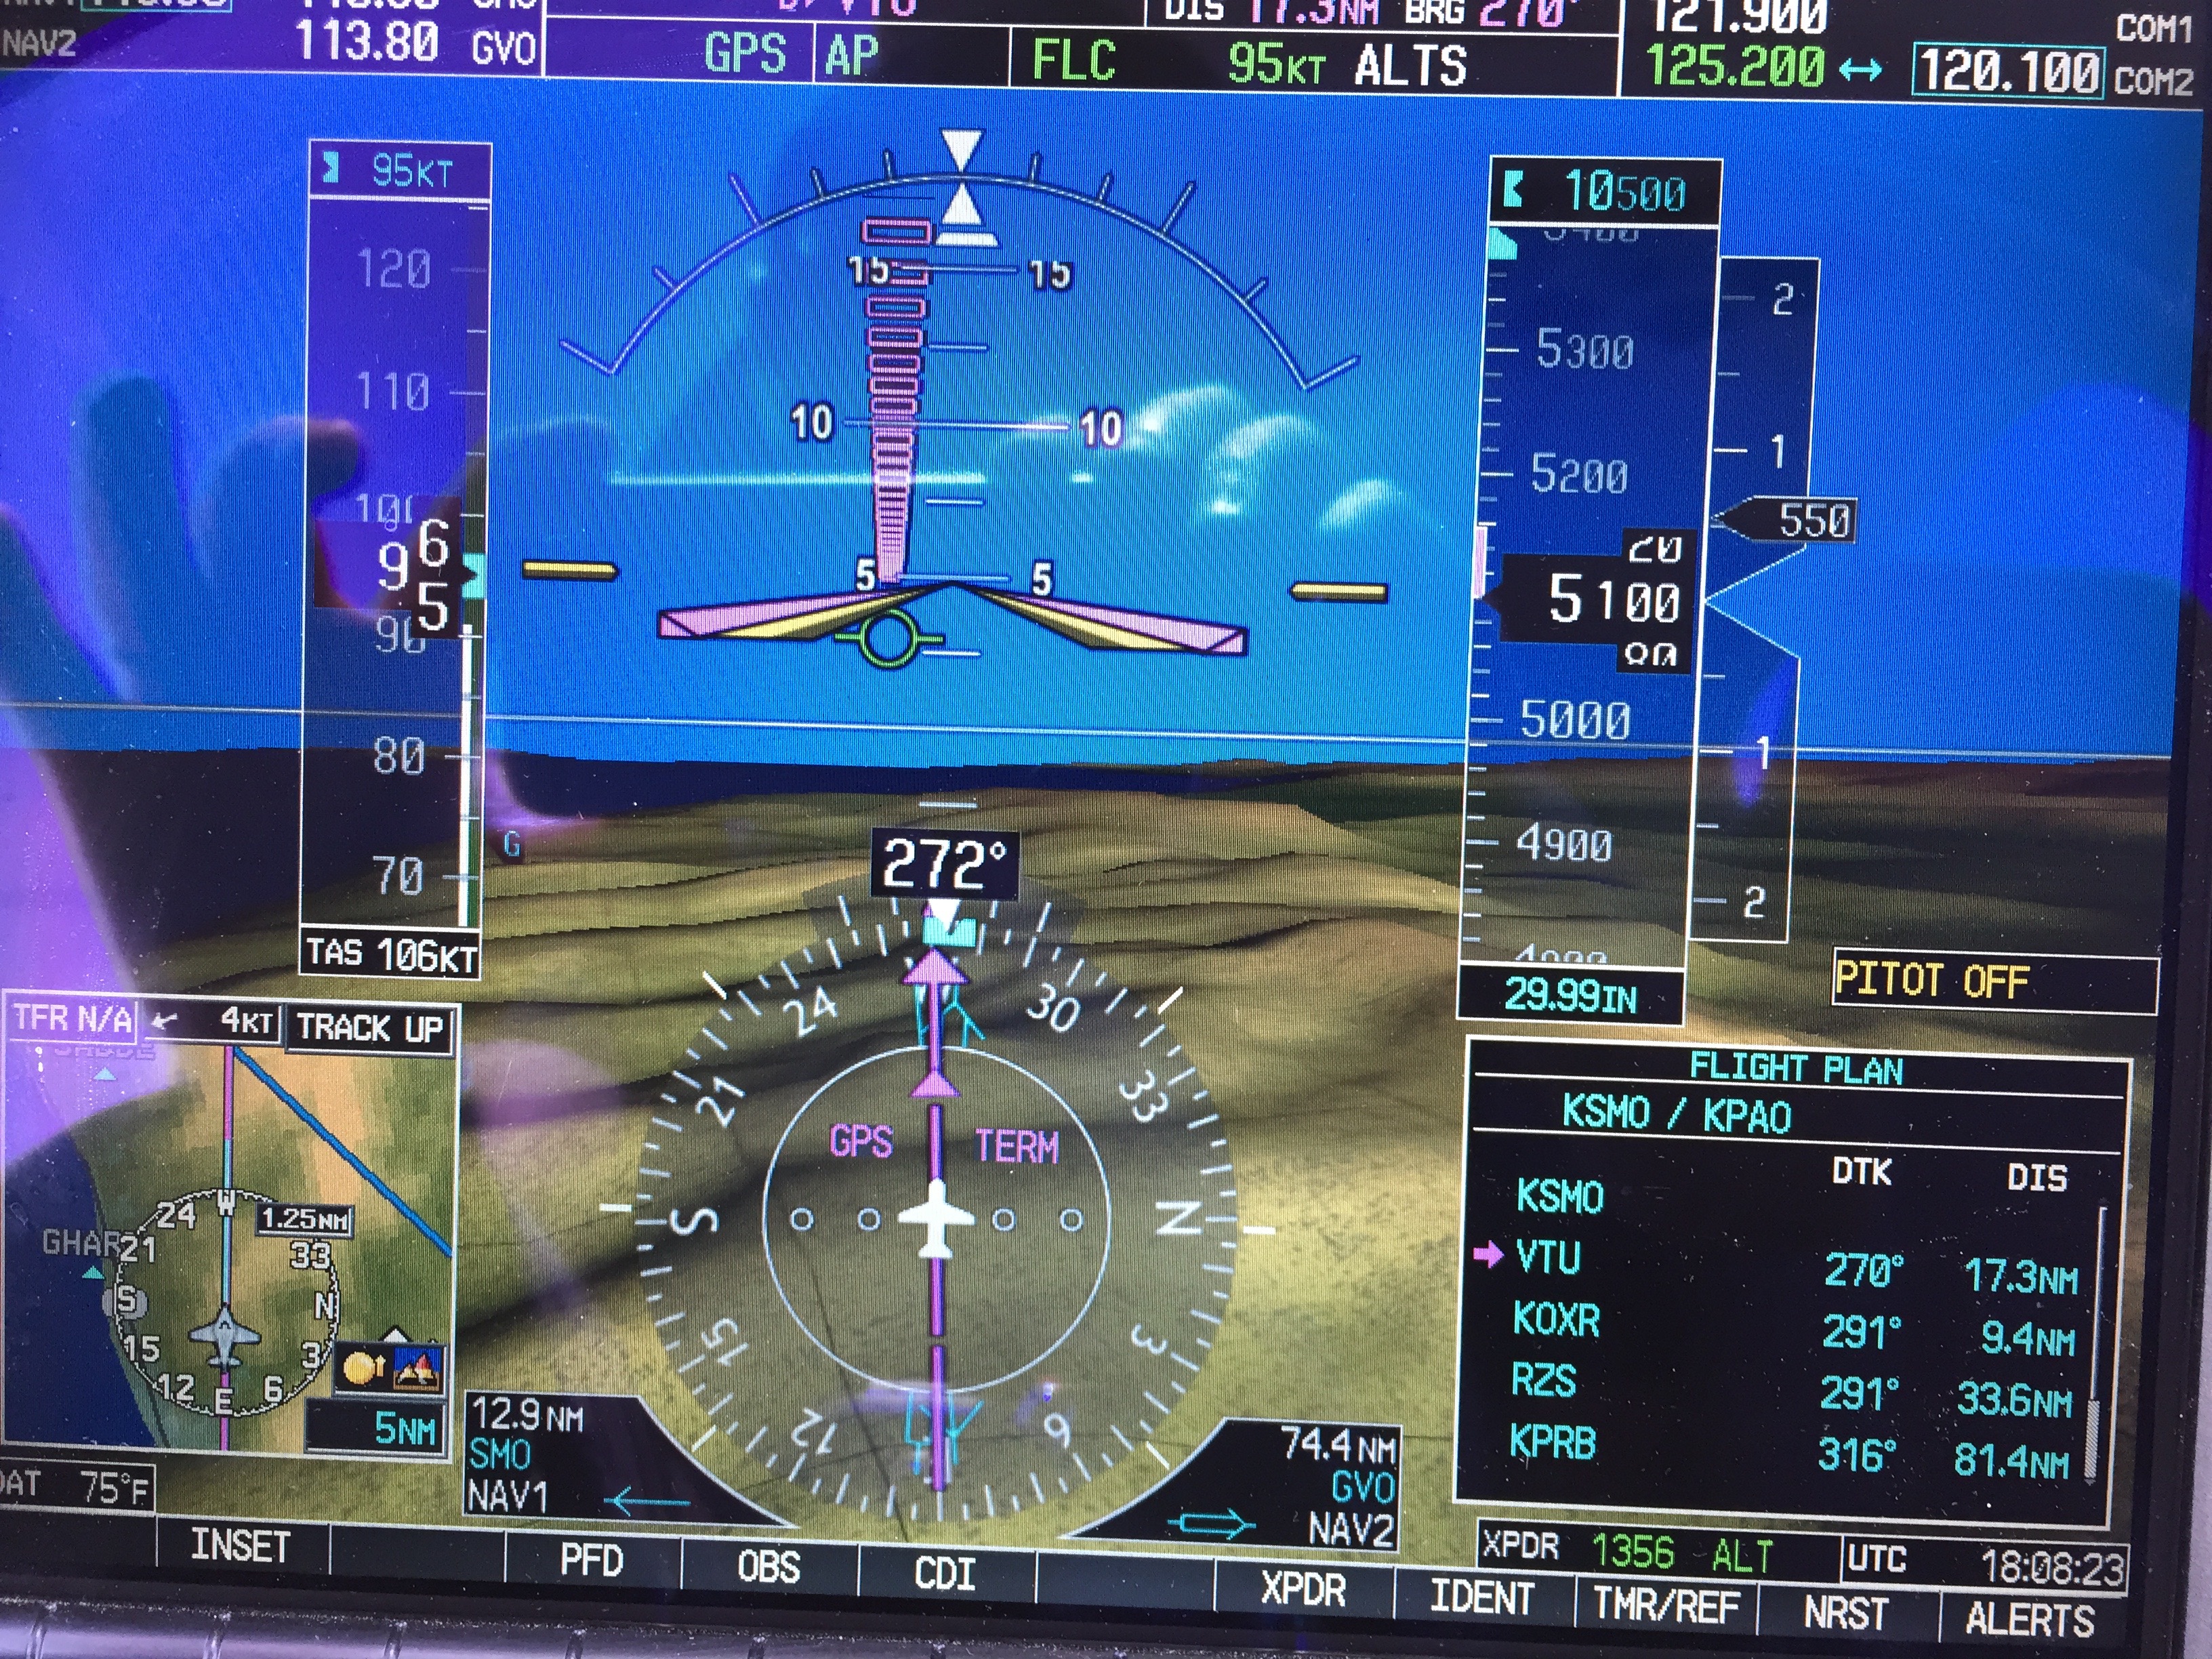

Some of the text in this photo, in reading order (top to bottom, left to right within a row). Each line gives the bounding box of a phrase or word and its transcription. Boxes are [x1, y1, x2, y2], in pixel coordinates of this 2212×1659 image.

[1406, 0, 1465, 24] BRG
[1656, 0, 1828, 34] 121.900
[2116, 13, 2192, 43] COM1
[3, 29, 77, 57] NAV2
[296, 19, 438, 62] 113.80
[473, 30, 537, 66] GVO
[705, 30, 786, 73] GPS
[825, 33, 879, 76] AP
[1034, 37, 1116, 81] FLC
[1229, 41, 1327, 85] 95KT
[1355, 43, 1468, 87] ALTS
[1647, 43, 1825, 87] 125.200
[1921, 47, 2101, 94] 120.100
[2114, 66, 2194, 97] COM2
[373, 152, 453, 188] 95KT
[1566, 169, 1686, 211] 10500
[358, 247, 431, 289] 120
[848, 256, 890, 285] 15
[1029, 260, 1073, 289] 15
[1773, 282, 1795, 316] 2
[1538, 327, 1635, 369] 5300
[358, 371, 430, 411] 110
[792, 404, 832, 439] 10
[1082, 411, 1122, 447] 10
[1771, 434, 1785, 470] 1
[1532, 453, 1628, 494] 5200
[1780, 503, 1850, 538] 550
[857, 558, 876, 592] 5
[1032, 562, 1052, 596] 5
[1520, 699, 1631, 740] 5000
[373, 736, 426, 775] 80
[1757, 735, 1769, 770] 1
[503, 830, 520, 858] G
[1516, 822, 1614, 864] 4900
[372, 856, 423, 897] 70
[884, 837, 1008, 889] 272°
[1744, 886, 1767, 918] 2
[305, 937, 479, 975] TAS 106KT
[1505, 976, 1638, 1015] 29.99IN
[1836, 959, 2032, 1000] PITOT OFF
[14, 1002, 133, 1033] TFR N/A
[221, 1006, 274, 1033] 4KT
[782, 985, 838, 1038] 24
[1026, 982, 1082, 1033] 30
[296, 1012, 445, 1044] TRACK UP
[1690, 1050, 1904, 1086] FLIGHT PLAN
[694, 1076, 747, 1128] 21
[1118, 1069, 1170, 1124] 33
[1563, 1092, 1652, 1129] KSMO
[1703, 1098, 1793, 1134] KPAO
[829, 1123, 895, 1160] GPS
[975, 1128, 1060, 1165] TERM
[1832, 1157, 2069, 1193] DTK DIS
[216, 1191, 236, 1216] W
[1517, 1178, 1605, 1215] KSMO
[157, 1202, 196, 1230] 24
[262, 1207, 349, 1231] 1.25NM
[42, 1228, 134, 1256] GHAR
[121, 1235, 155, 1263] 21
[290, 1241, 331, 1269] 33
[1517, 1240, 2078, 1295] VTU 270° 17.3NM
[118, 1285, 136, 1311] S
[314, 1293, 335, 1319] N
[1513, 1300, 2076, 1357] KOXR 291° 9.4NM
[123, 1336, 161, 1362] 15
[302, 1341, 321, 1368] 3
[158, 1374, 194, 1401] 12
[215, 1388, 233, 1415] E
[264, 1375, 283, 1403] 6
[1511, 1362, 2073, 1419] RZS 291° 33.6NM
[375, 1411, 436, 1446] 5NM
[469, 1437, 531, 1471] SMO
[1509, 1423, 2070, 1480] KPRB 316° 81.4NM
[81, 1471, 148, 1504] 75°F
[468, 1479, 548, 1513] NAV1
[1332, 1469, 1396, 1504] GVO
[191, 1528, 291, 1564] INSET
[1309, 1511, 1395, 1548] NAV2
[560, 1544, 624, 1578] PFD
[738, 1551, 802, 1584] OBS
[1482, 1530, 1774, 1574] XPDR 1356 ALT
[1849, 1542, 2125, 1587] UTC 18:08:23
[915, 1555, 977, 1591] CDI
[1262, 1570, 1347, 1607] XPDR
[1431, 1578, 1536, 1616] IDENT
[1594, 1585, 1740, 1625] TMR/REF
[1805, 1594, 1889, 1632] NRST
[1966, 1601, 2096, 1637] ALERTS
